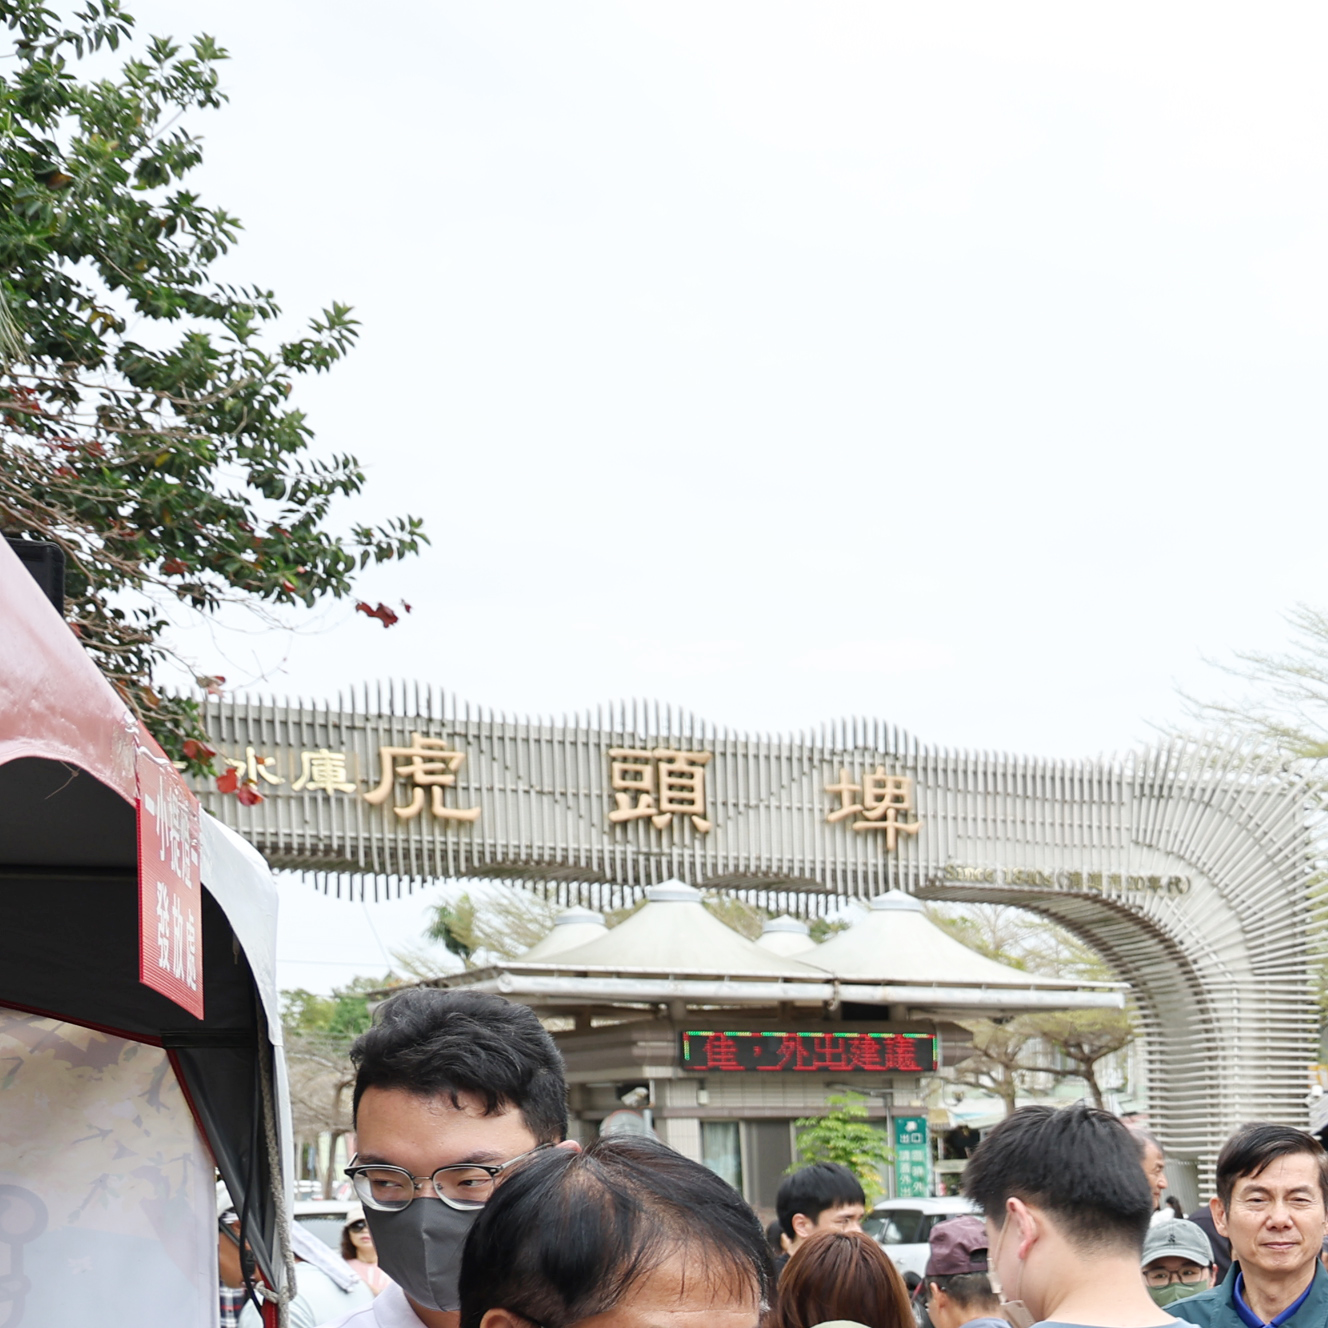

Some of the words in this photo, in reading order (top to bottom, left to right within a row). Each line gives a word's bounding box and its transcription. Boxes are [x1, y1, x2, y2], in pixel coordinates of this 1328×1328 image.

[364, 732, 923, 852] 虎頭埤
[156, 881, 197, 991] 發放處
[899, 1133, 923, 1144] 出口
